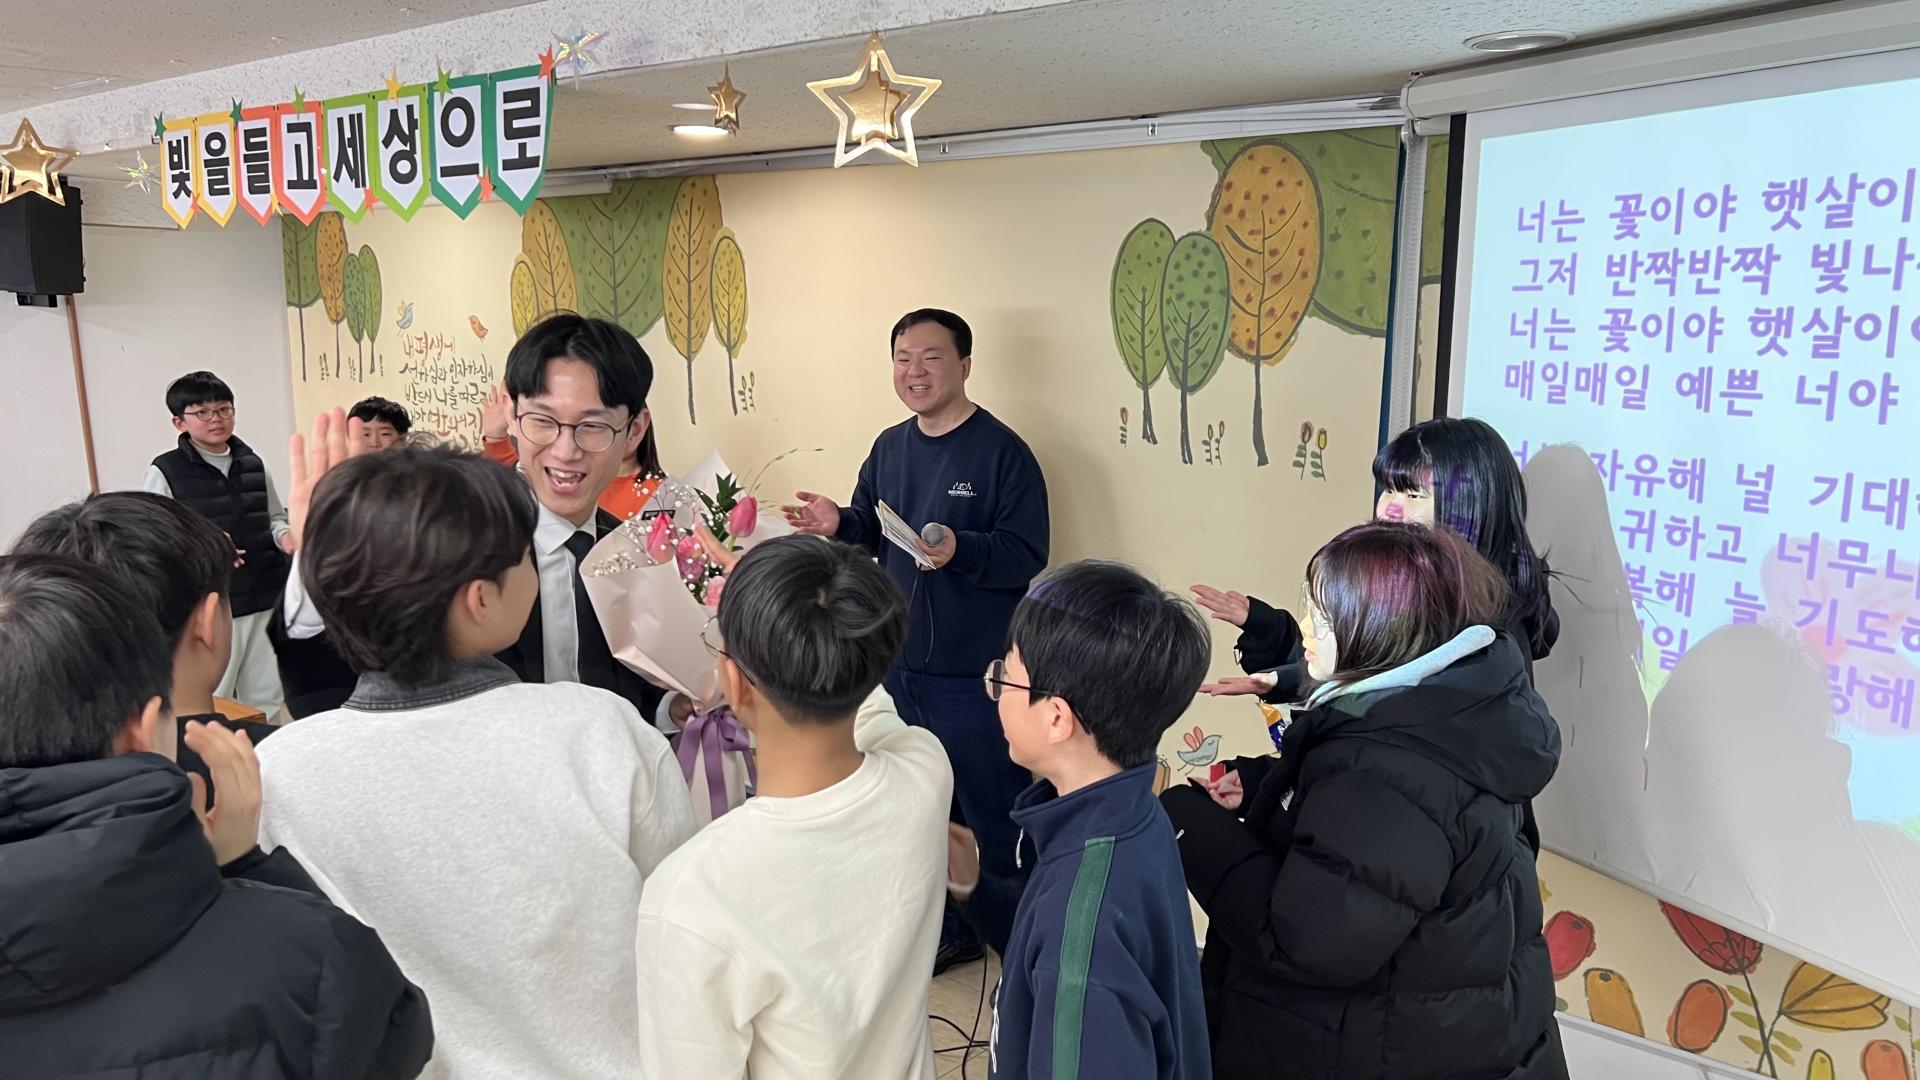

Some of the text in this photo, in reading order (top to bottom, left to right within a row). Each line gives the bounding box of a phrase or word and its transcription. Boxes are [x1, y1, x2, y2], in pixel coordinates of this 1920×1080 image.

[1517, 199, 1586, 243] 너는
[1608, 184, 1738, 241] 꽃이야
[1511, 236, 1920, 298] 그저 반짝반짝 빛나
[1510, 308, 1577, 352] 너는
[1598, 306, 1726, 354] 꽃이야
[1504, 360, 1900, 425] 매일매일 예쁜 너야
[1735, 463, 1775, 515] 널
[1808, 472, 1920, 530] 기대
[1725, 581, 1767, 626] 늘
